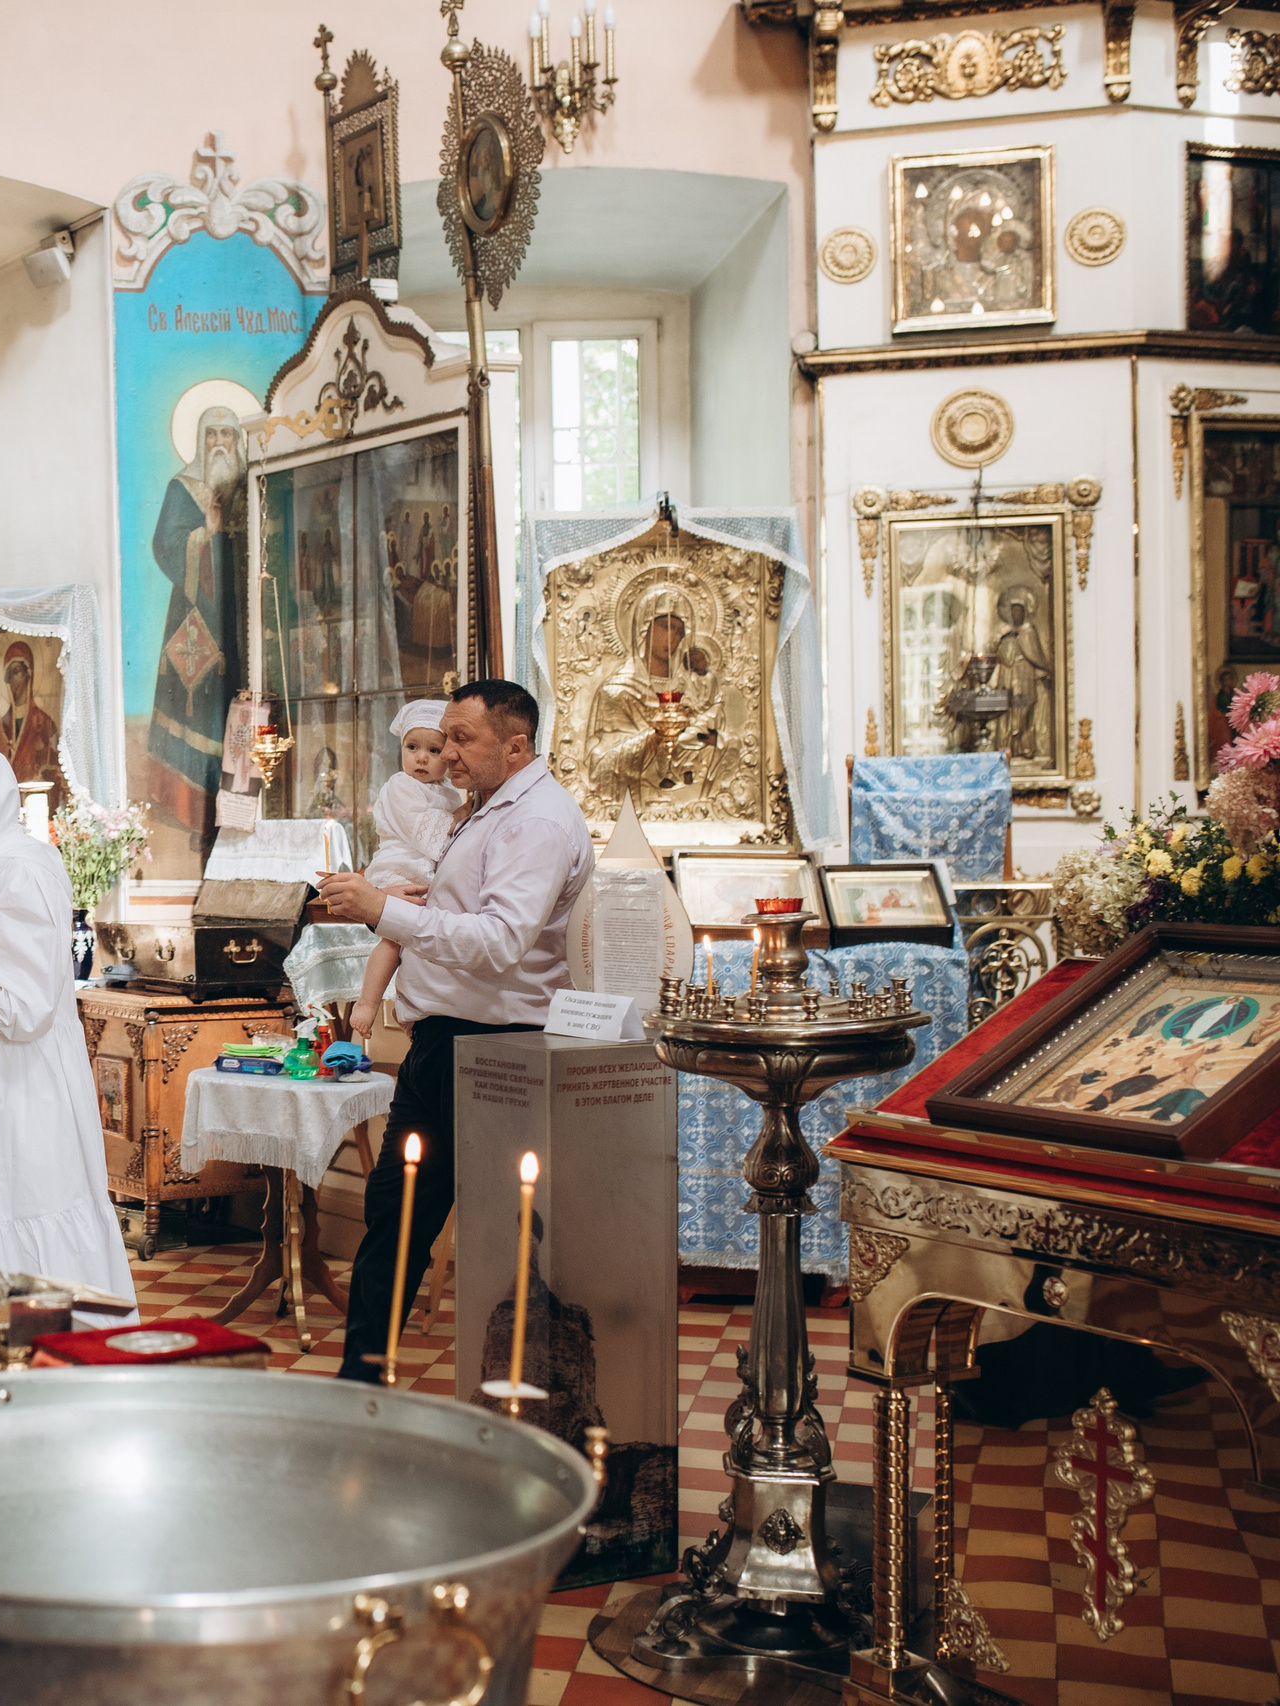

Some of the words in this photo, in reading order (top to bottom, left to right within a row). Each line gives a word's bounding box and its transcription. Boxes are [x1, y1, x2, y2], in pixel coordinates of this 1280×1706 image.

[148, 302, 171, 333] Св.
[585, 1022, 601, 1031] СВО
[475, 1057, 527, 1072] ВОССТАНОВИМ
[566, 1066, 598, 1076] ПРОСИМ
[599, 1064, 617, 1074] ВСЕХ
[618, 1061, 663, 1073] ЖЕЛАЮЩИХ
[509, 1073, 544, 1087] СВЯТЫНИ
[556, 1082, 590, 1093] ПРИНЯТЬ
[592, 1078, 639, 1090] ЖЕРТВЕННОЕ
[640, 1076, 672, 1087] УЧАСТИЕ
[474, 1080, 488, 1090] КАК
[489, 1082, 528, 1096] ПОКАЯНИЕ
[472, 1091, 481, 1100] ЗА
[482, 1093, 504, 1104] НАШИ
[581, 1096, 601, 1106] ЭТОМ
[603, 1094, 632, 1105] БЛАГОМ
[633, 1092, 654, 1104] ДЕЛЕ!
